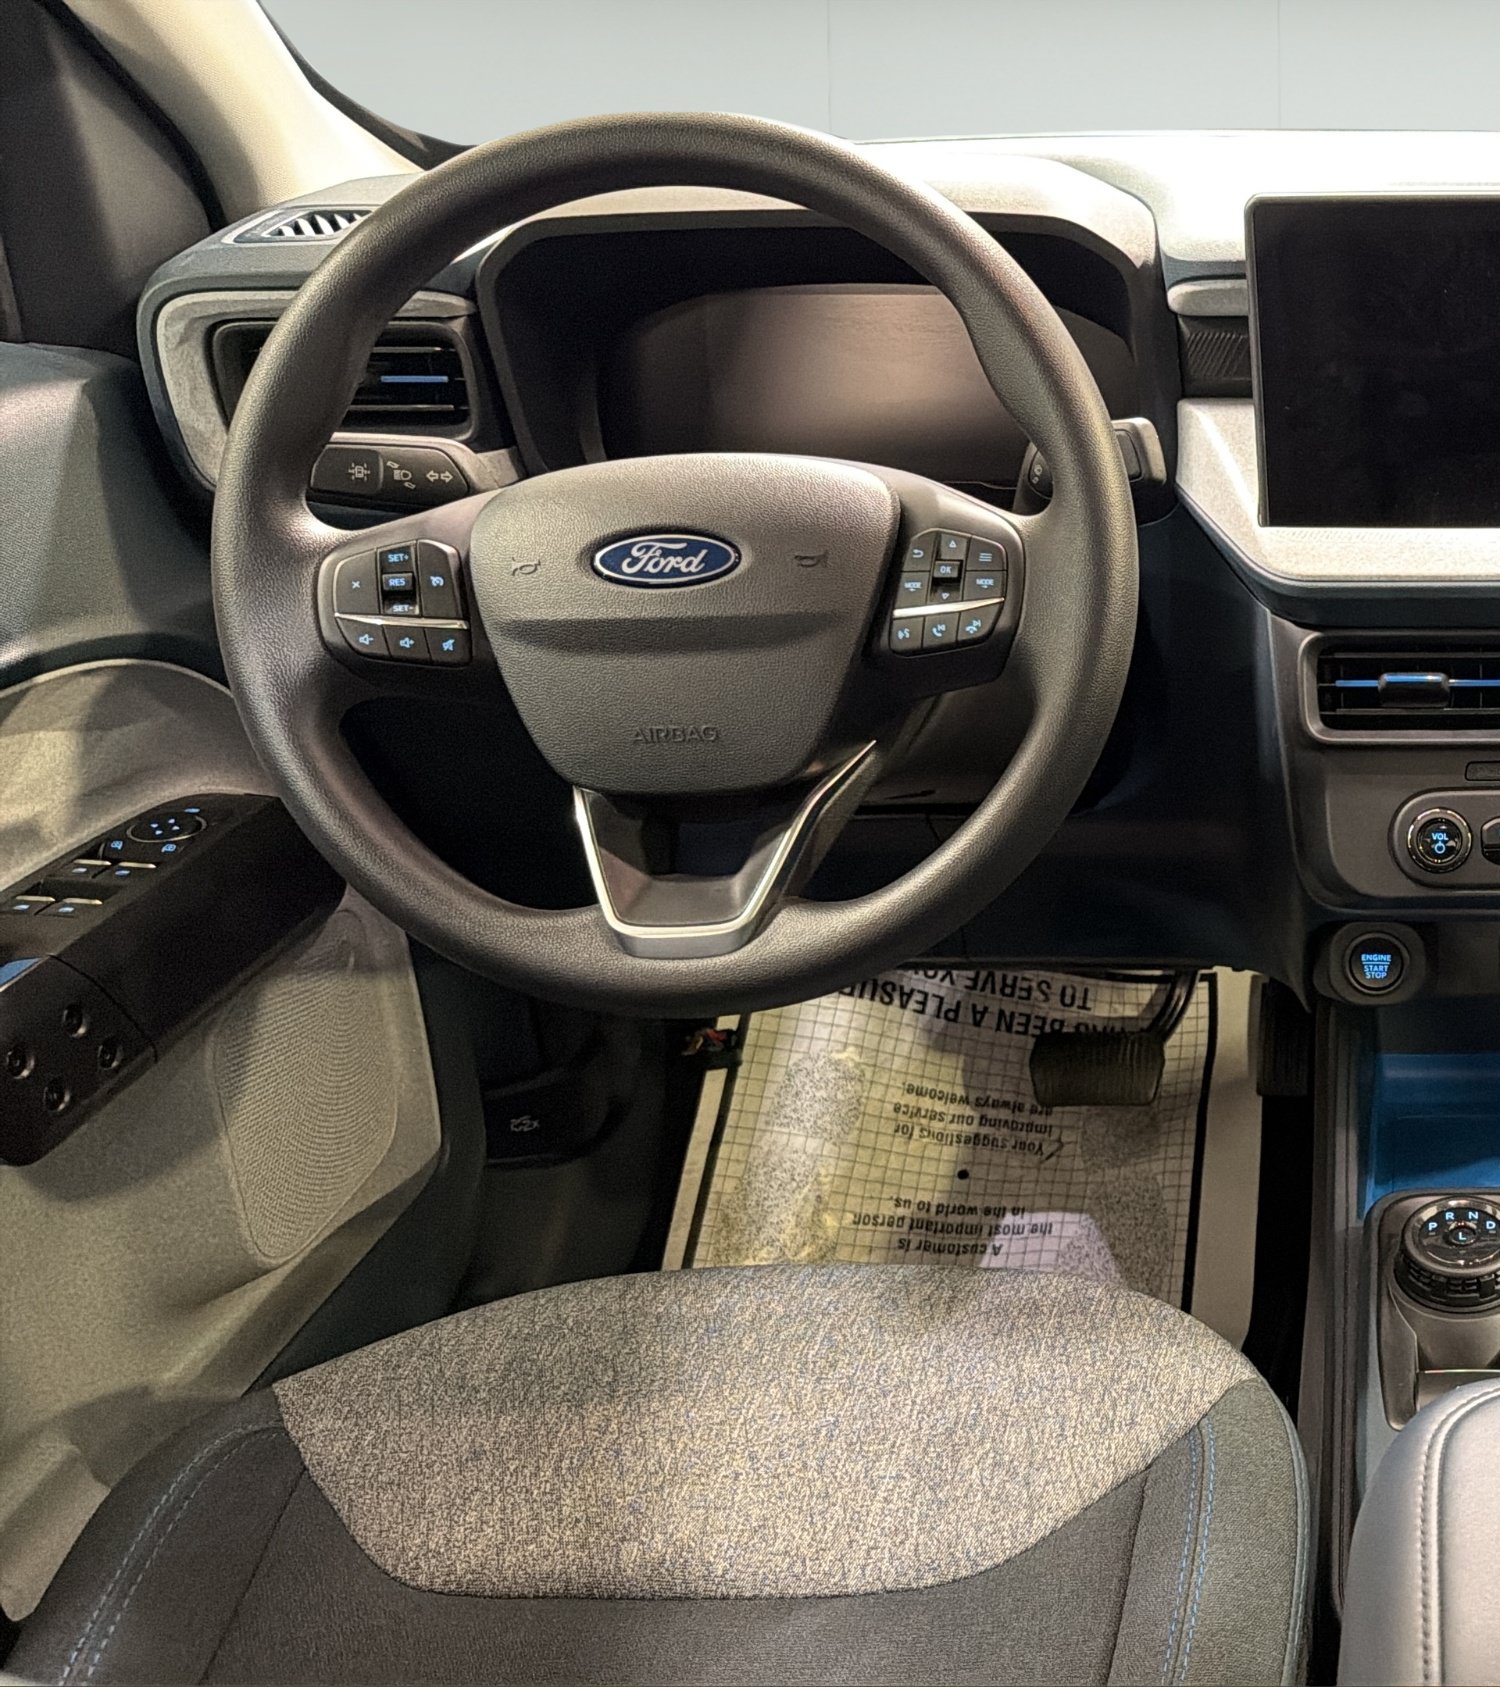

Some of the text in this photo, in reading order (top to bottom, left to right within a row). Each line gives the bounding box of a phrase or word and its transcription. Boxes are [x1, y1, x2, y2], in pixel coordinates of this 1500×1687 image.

[388, 553, 409, 562] SET+
[621, 541, 709, 574] Ford
[940, 565, 952, 574] OK
[389, 578, 406, 586] RES
[976, 578, 994, 586] MODE
[634, 725, 720, 743] AIRBAG
[1431, 832, 1449, 841] VOL
[1361, 954, 1392, 962] ENGINE
[1363, 965, 1388, 973] START
[1365, 971, 1387, 979] STOP
[1060, 985, 1092, 1011] TO
[972, 1003, 989, 1028] A
[975, 1096, 1026, 1114] always
[1029, 1103, 1054, 1117] are
[893, 1102, 1054, 1137] improving our service
[894, 1123, 1044, 1156] Your suggestions for
[890, 1196, 1026, 1219] in the world to us.
[852, 1213, 1054, 1236] the most important person
[1428, 1211, 1496, 1231] P R N D
[1458, 1232, 1467, 1240] L
[897, 1237, 1005, 1256] A customer is
